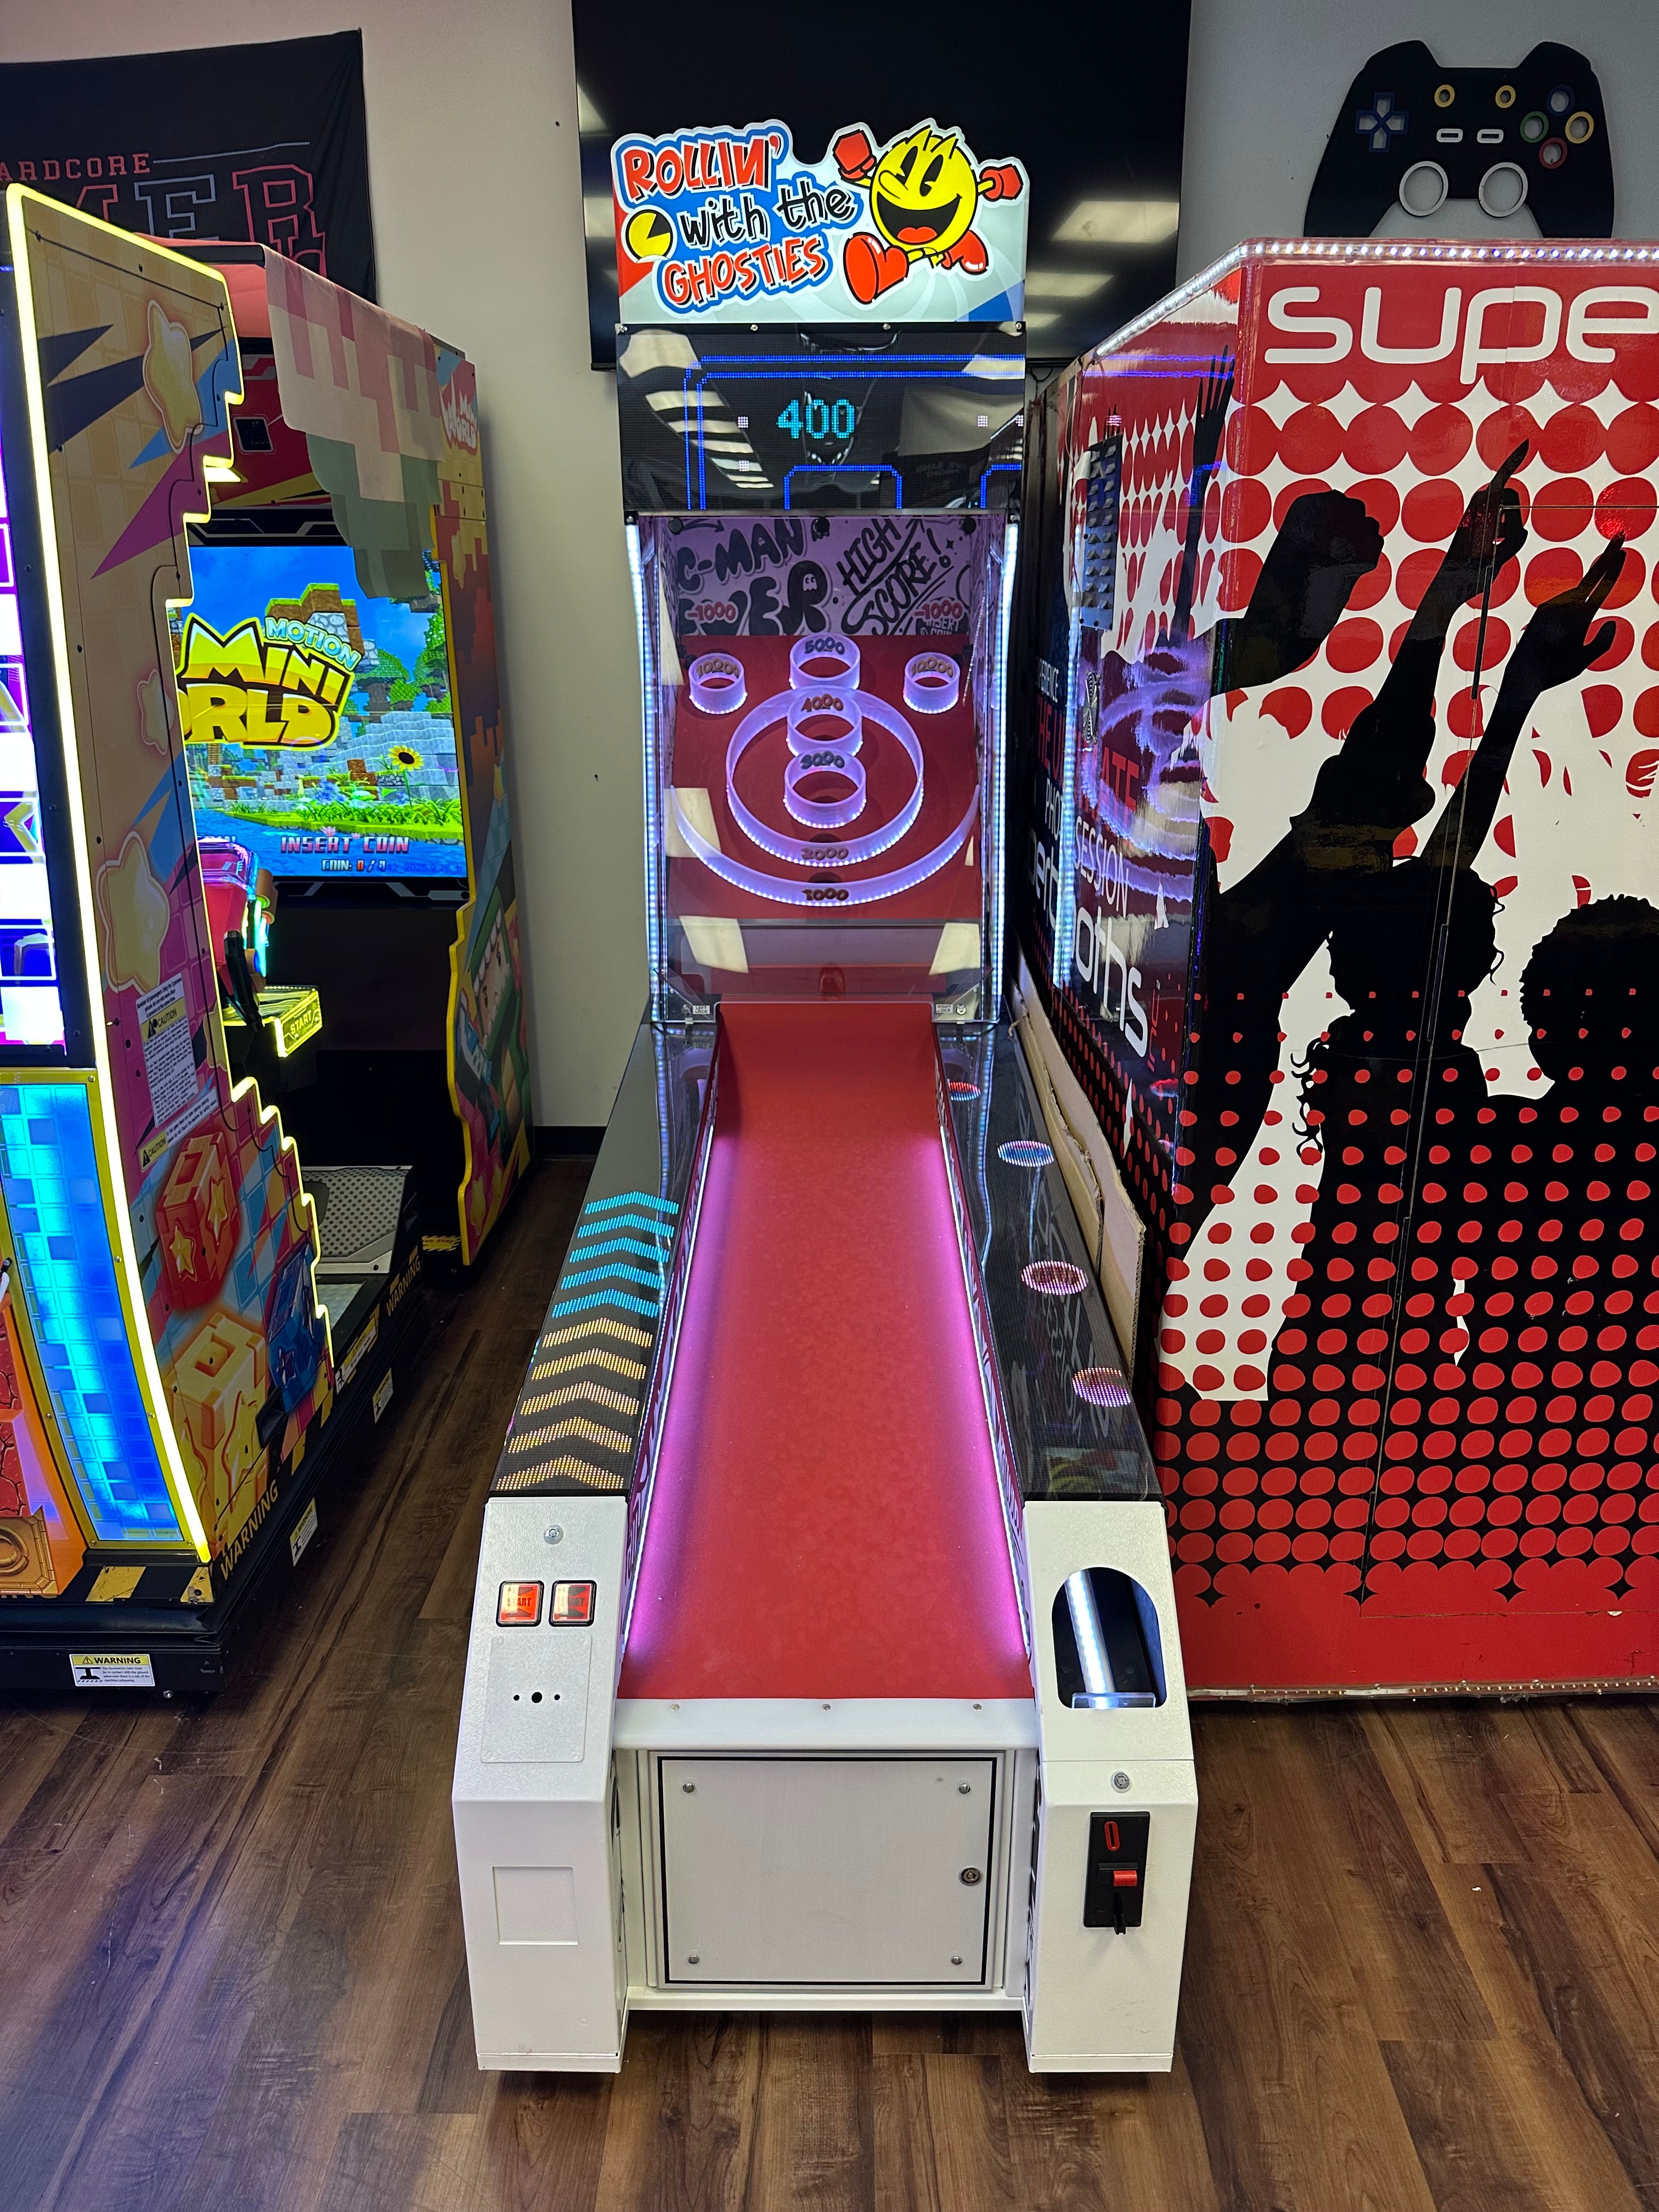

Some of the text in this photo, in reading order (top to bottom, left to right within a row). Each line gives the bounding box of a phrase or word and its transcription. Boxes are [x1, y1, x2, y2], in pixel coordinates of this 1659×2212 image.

[623, 135, 781, 201] ROLLIN'
[679, 178, 857, 248] with the
[664, 235, 825, 307] GHOSTIES
[1265, 286, 1659, 384] supe
[776, 399, 855, 439] 400
[837, 518, 901, 596] HIGH
[915, 600, 963, 619] -1000
[266, 618, 359, 670] MOTION
[804, 637, 845, 655] 5000
[181, 622, 346, 706] MINI
[696, 658, 740, 678] 10000
[911, 656, 953, 678] 10000
[801, 693, 844, 712] 4000
[800, 752, 845, 769] 3000
[280, 836, 410, 854] INSERT COIN
[800, 848, 848, 861] 2000
[1075, 816, 1128, 919] SESSION
[801, 888, 849, 901] 1000
[157, 1008, 177, 1028] CAUTION
[290, 1009, 311, 1035] START
[148, 1137, 166, 1158] CAUTION
[386, 1255, 421, 1317] WARNING
[221, 1479, 279, 1581] WARNING
[507, 1597, 532, 1606] START
